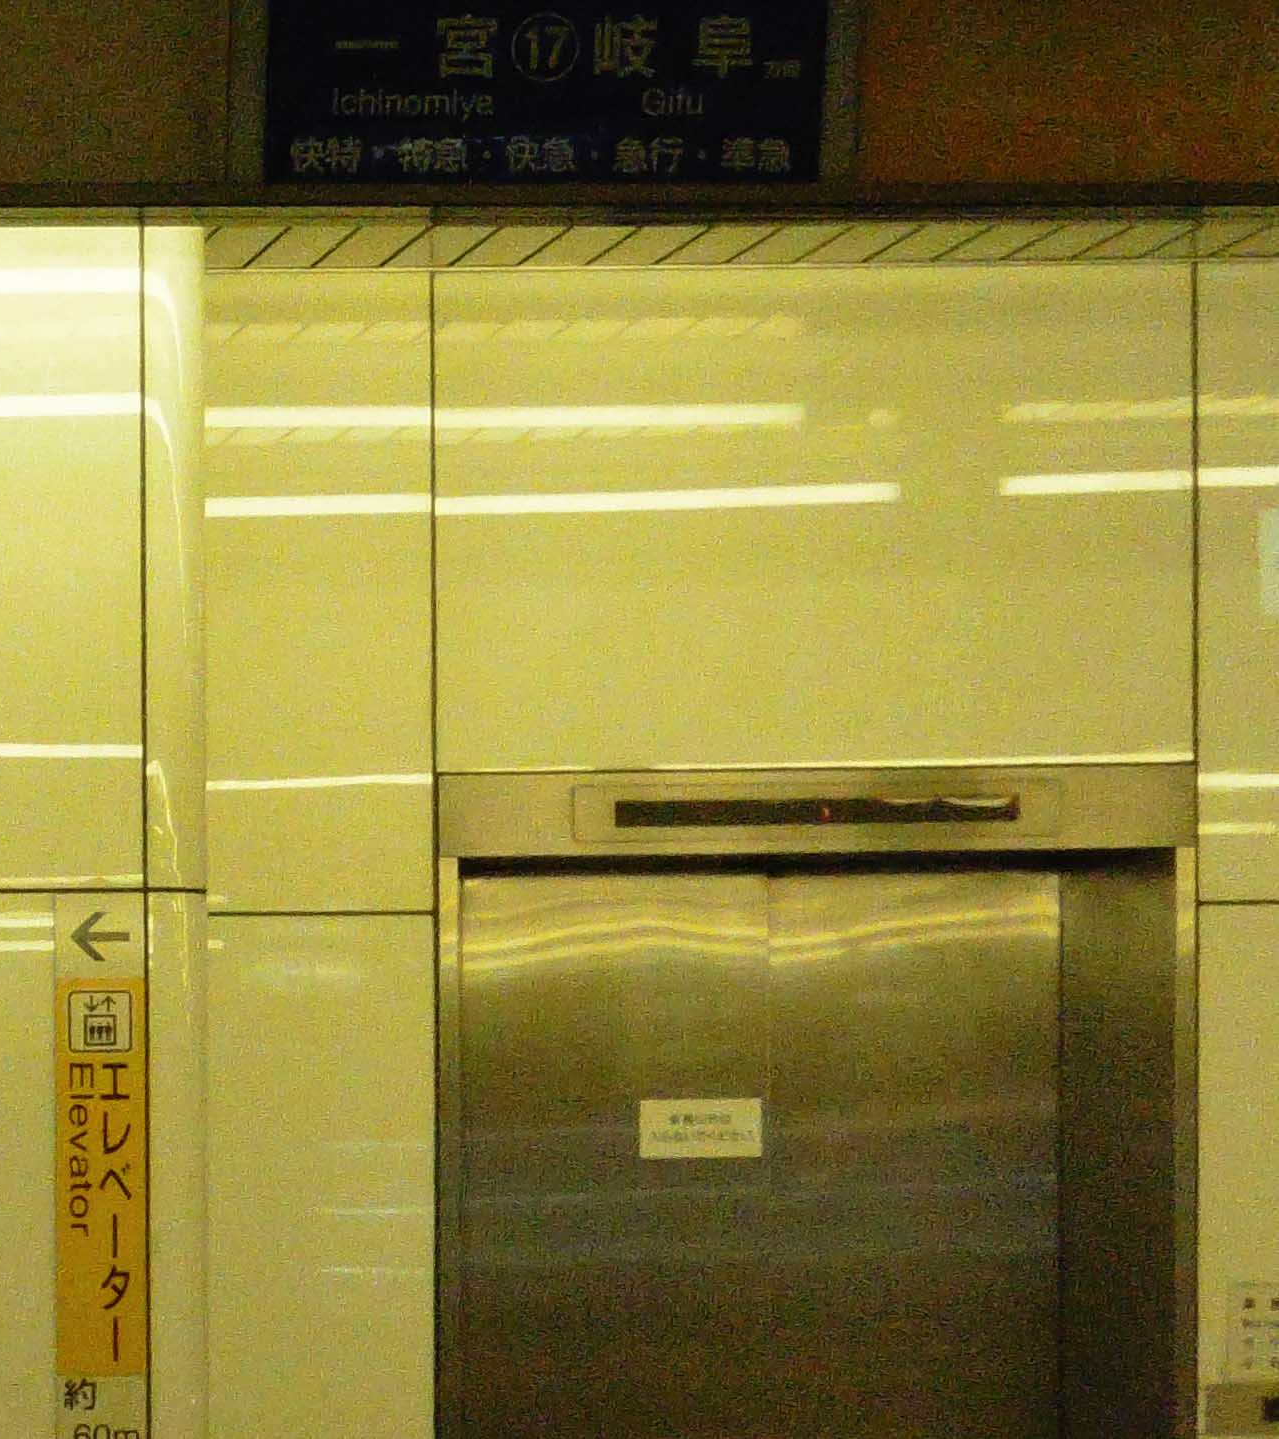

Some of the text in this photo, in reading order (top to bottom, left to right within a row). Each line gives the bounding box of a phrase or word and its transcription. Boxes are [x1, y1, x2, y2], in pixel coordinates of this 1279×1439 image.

[333, 13, 498, 79] 一宮
[592, 13, 755, 80] 岐阜
[331, 87, 706, 123] Ichinomiya Gifu
[68, 1062, 95, 1238] Elevator
[100, 1062, 132, 1363] エレベーター
[63, 1378, 98, 1411] 約
